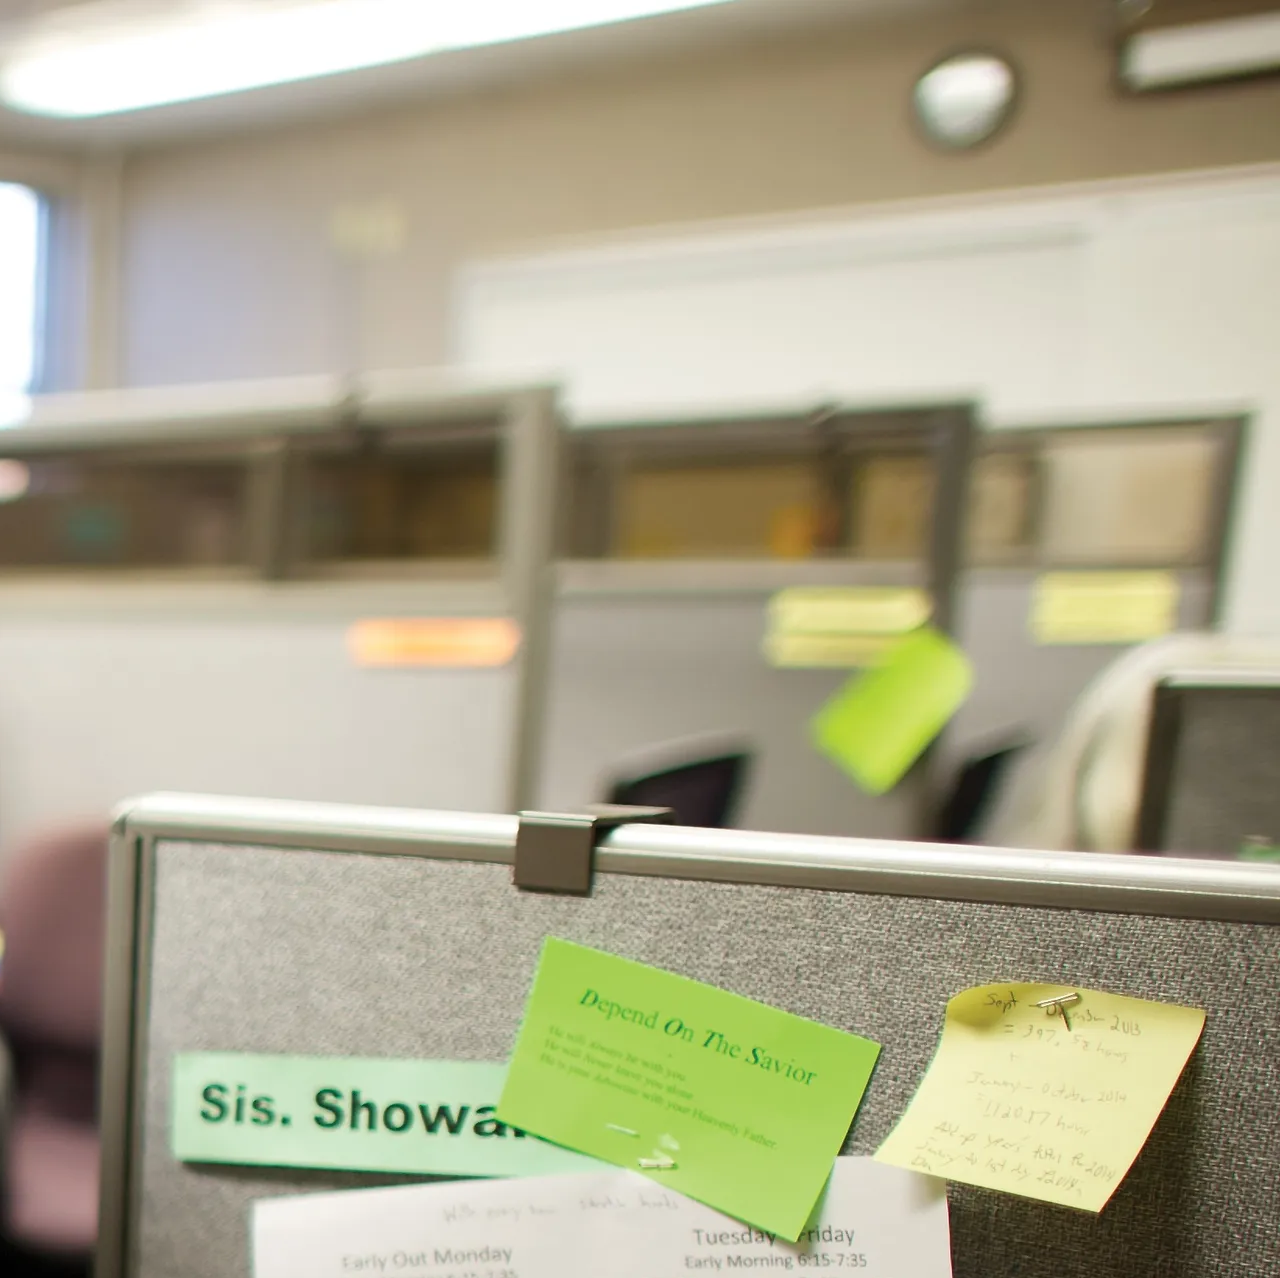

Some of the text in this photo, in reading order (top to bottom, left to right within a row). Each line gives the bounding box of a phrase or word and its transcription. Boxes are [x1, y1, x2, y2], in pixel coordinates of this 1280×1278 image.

[579, 988, 817, 1087] Depend On The Savior
[200, 1082, 527, 1139] Sis. Showa
[692, 1227, 777, 1246] Tuesday
[342, 1246, 514, 1272] Early Out Monday
[684, 1253, 868, 1271] Early Morning 6:15-7:35
